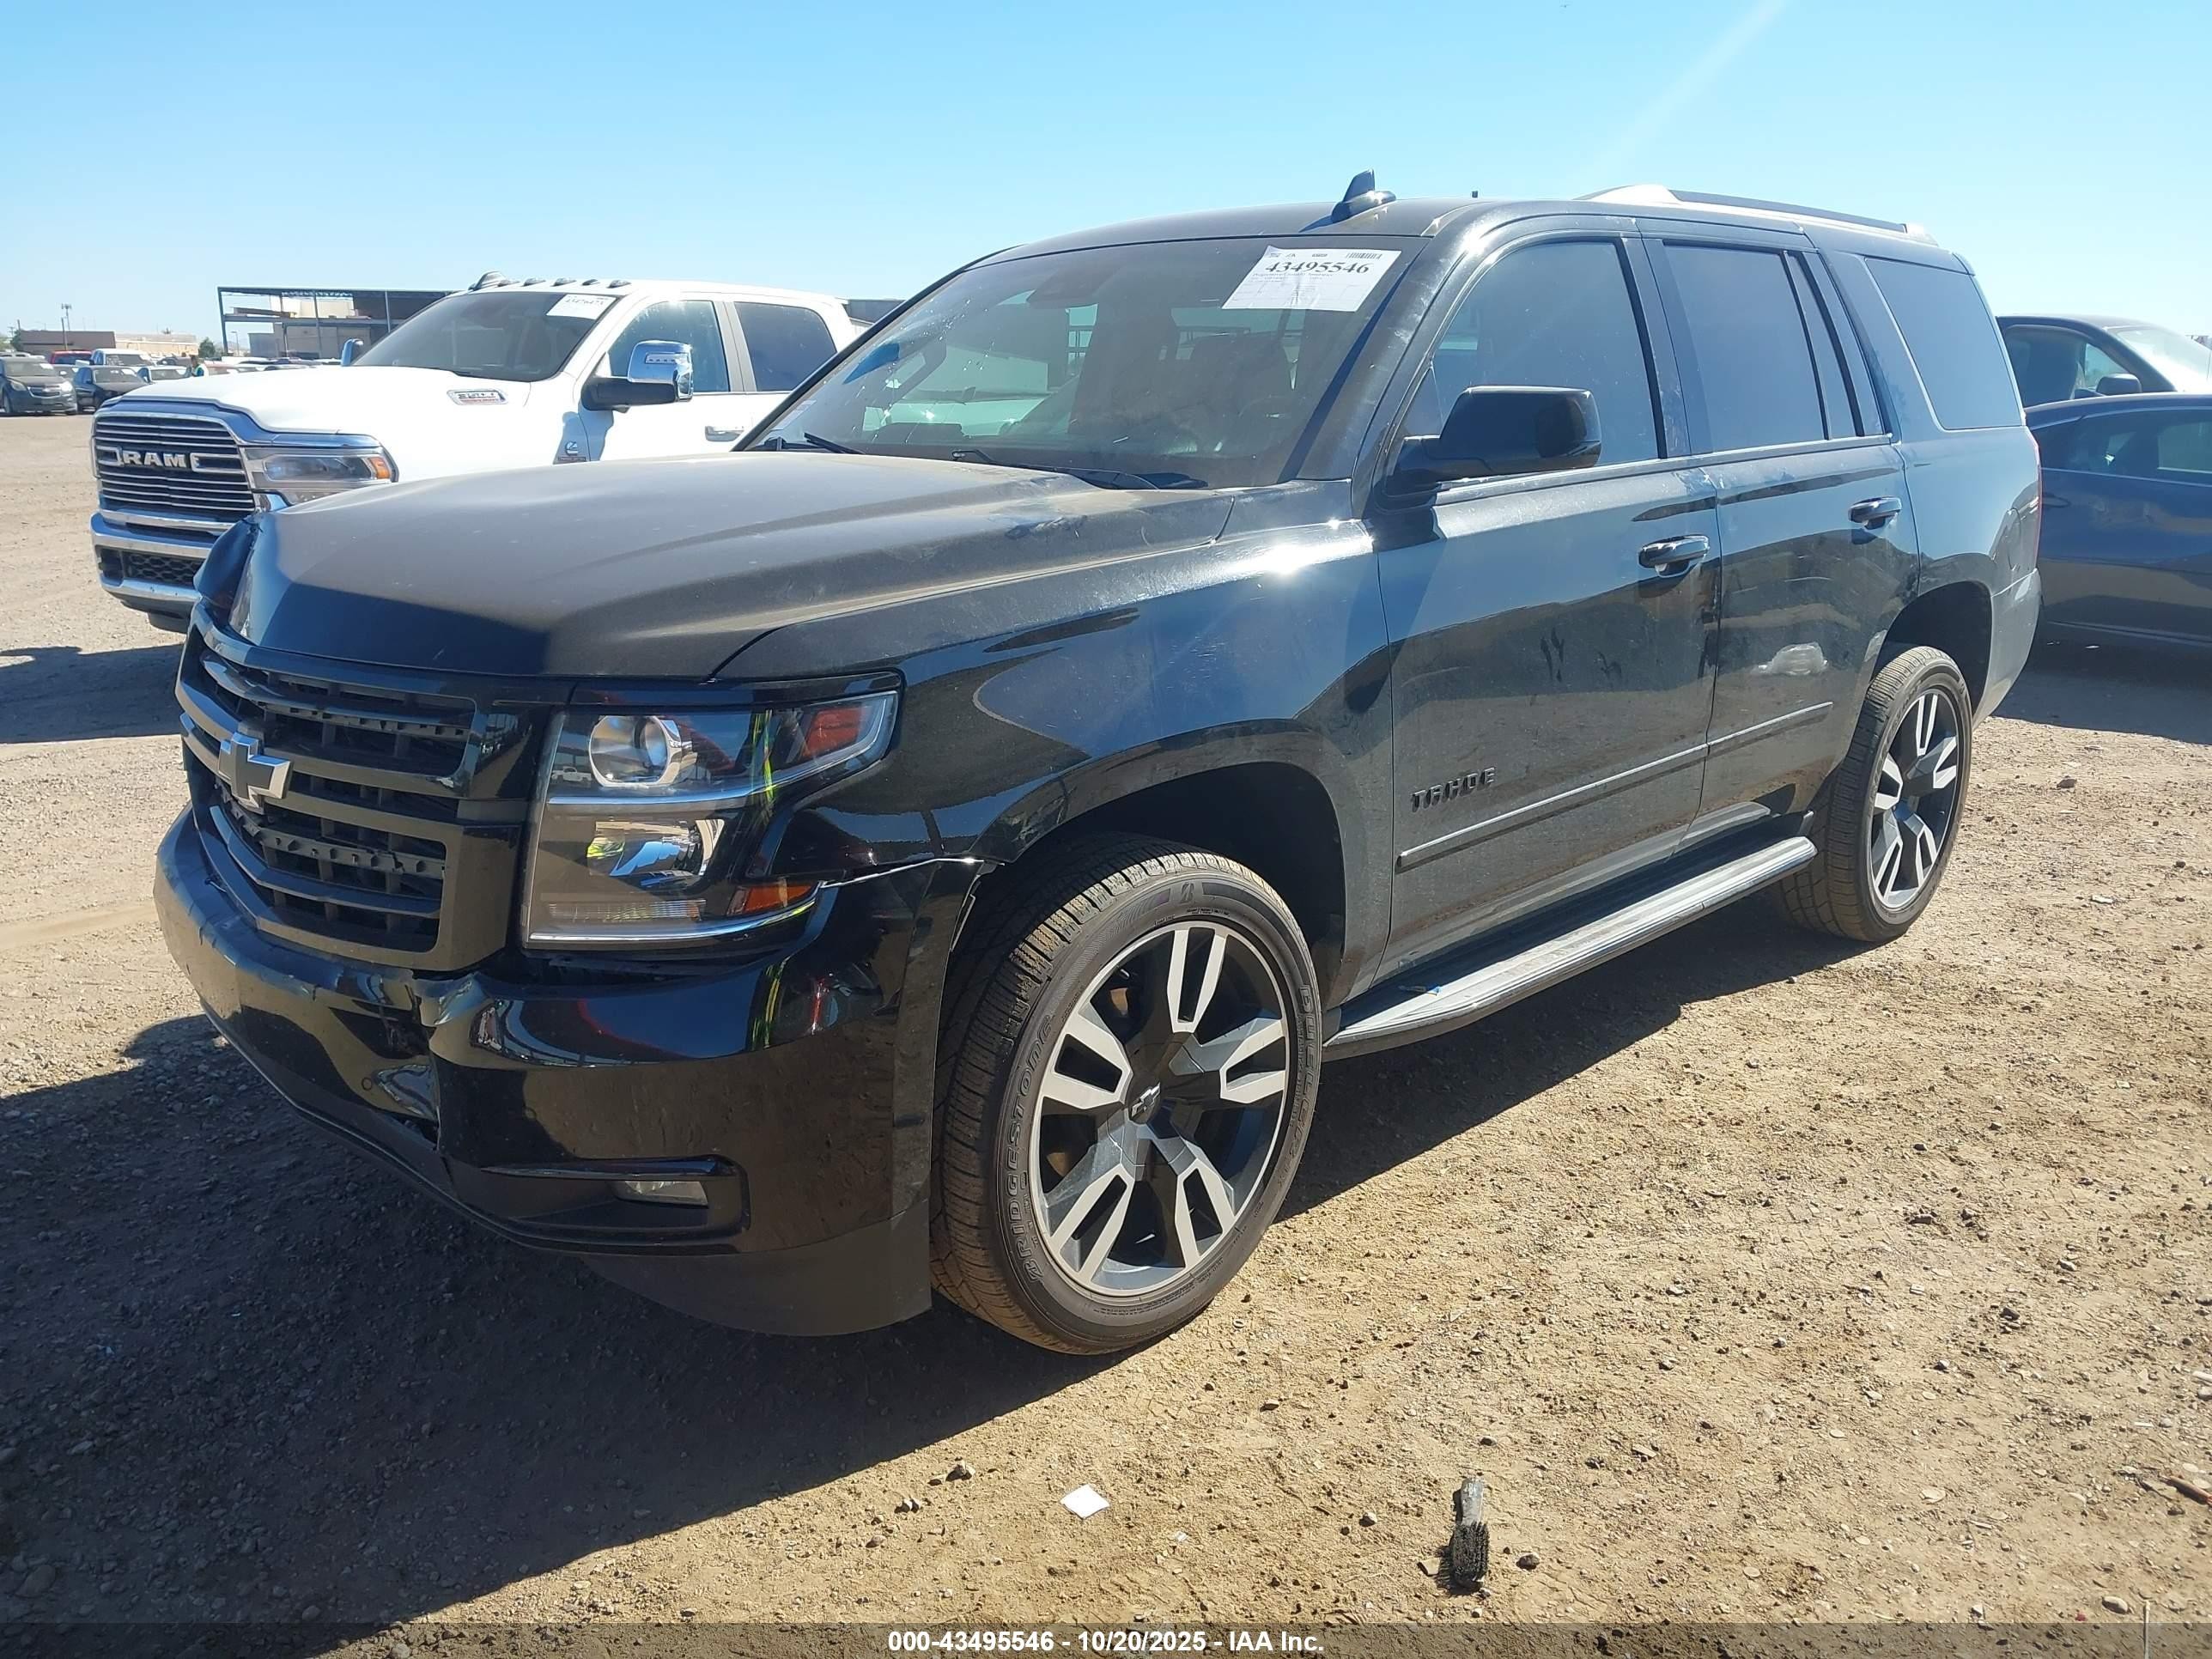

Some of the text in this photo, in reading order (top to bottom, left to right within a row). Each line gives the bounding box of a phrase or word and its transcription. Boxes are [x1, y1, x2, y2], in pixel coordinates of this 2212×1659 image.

[1265, 261, 1373, 274] 43495546
[122, 450, 187, 468] RAM
[1411, 767, 1496, 810] TAHOE
[1006, 1013, 1055, 1286] BRIDGESTONE
